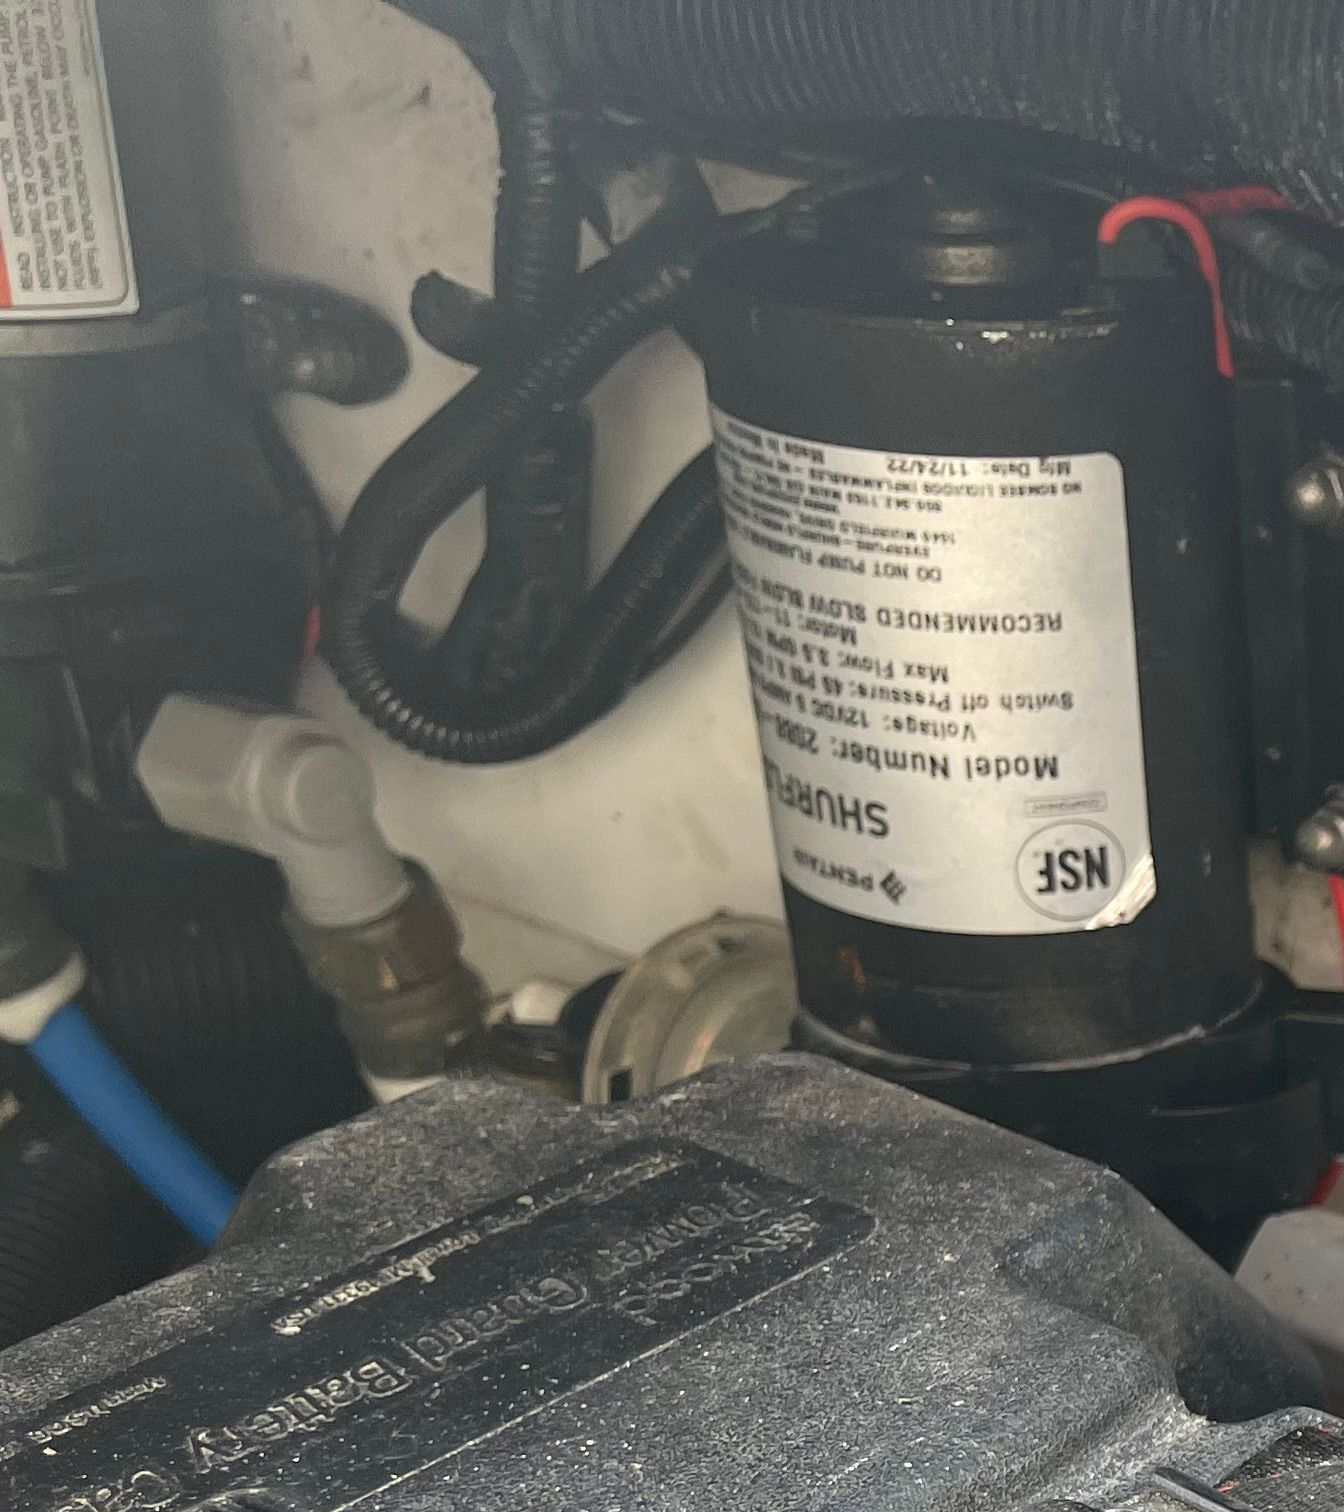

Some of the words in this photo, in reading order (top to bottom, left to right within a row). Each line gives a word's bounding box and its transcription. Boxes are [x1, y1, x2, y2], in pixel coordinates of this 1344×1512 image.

[916, 566, 942, 583] DO
[876, 608, 1063, 633] RECOMMENDED
[904, 663, 949, 685] Max
[849, 681, 951, 712] Pressure:
[999, 692, 1073, 713] Switch
[884, 715, 976, 742] Voltage:
[831, 736, 949, 779] Number:
[965, 755, 1059, 780] Model
[1037, 846, 1110, 896] NSF
[595, 1182, 774, 1279] Power
[399, 1276, 588, 1372] Guard
[184, 1360, 413, 1475] Battery
